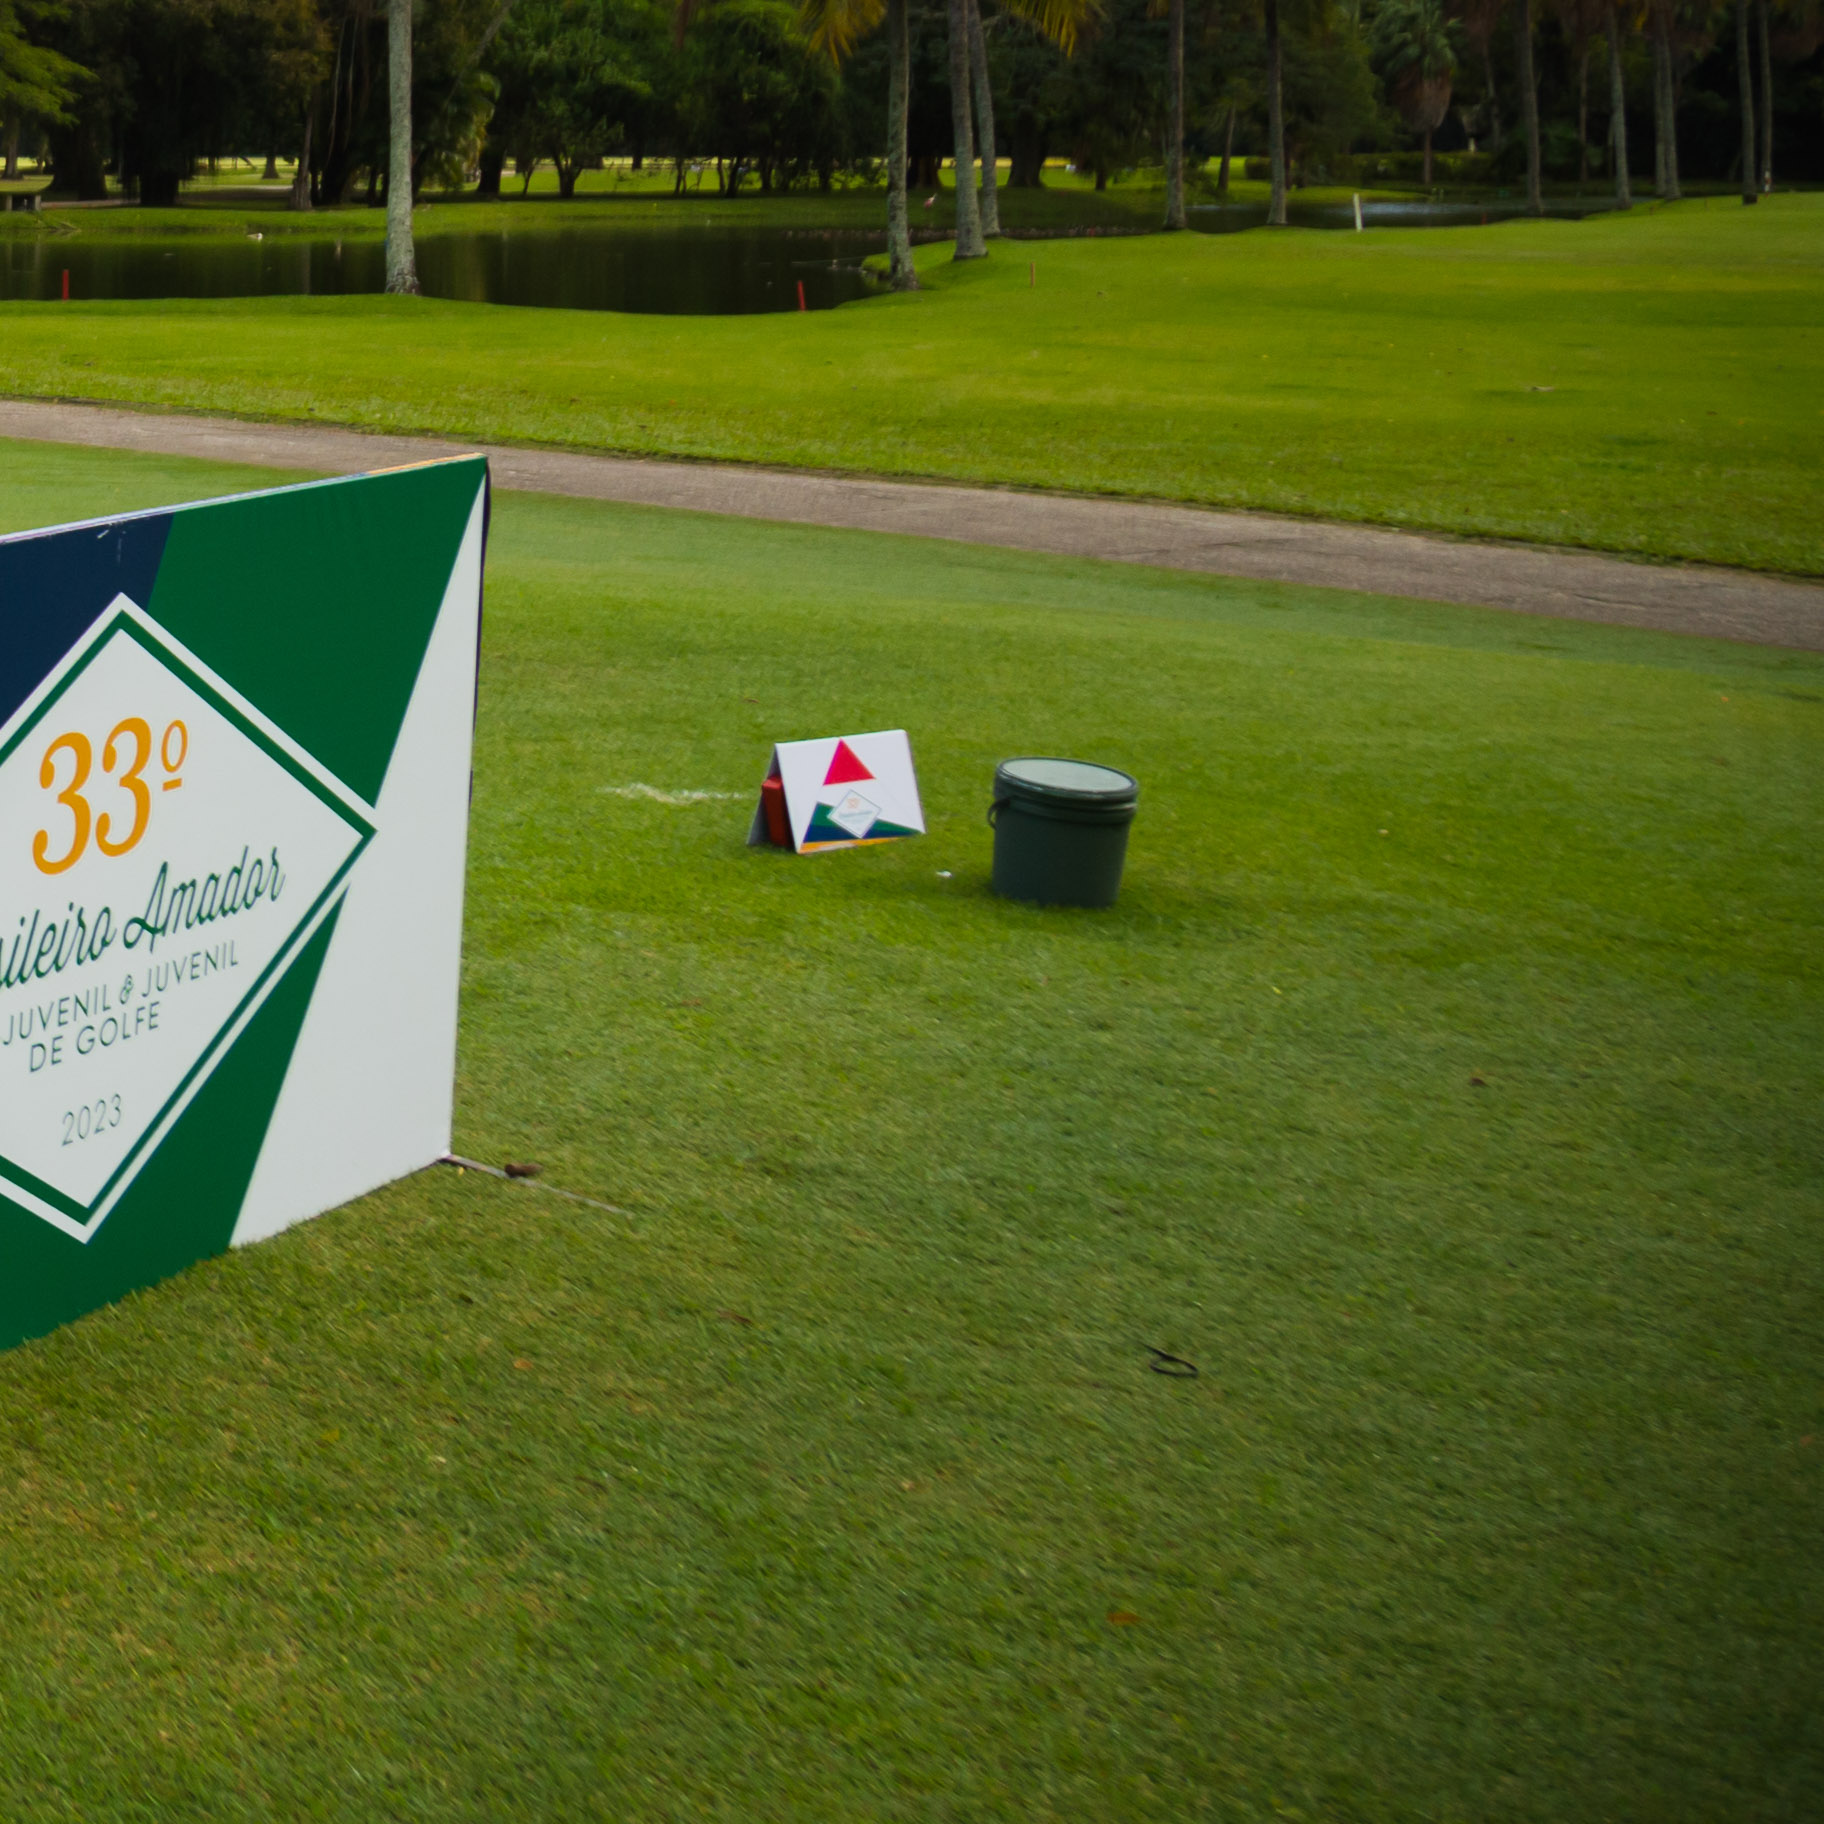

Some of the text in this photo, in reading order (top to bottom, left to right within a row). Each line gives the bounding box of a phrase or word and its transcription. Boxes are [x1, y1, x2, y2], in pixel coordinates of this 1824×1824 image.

[31, 715, 189, 876] 33º
[122, 844, 286, 955] Amador
[119, 973, 135, 1006] &
[141, 940, 239, 999] JUVENIL
[29, 1000, 161, 1073] DE GOLFE
[61, 1092, 122, 1147] 2023
